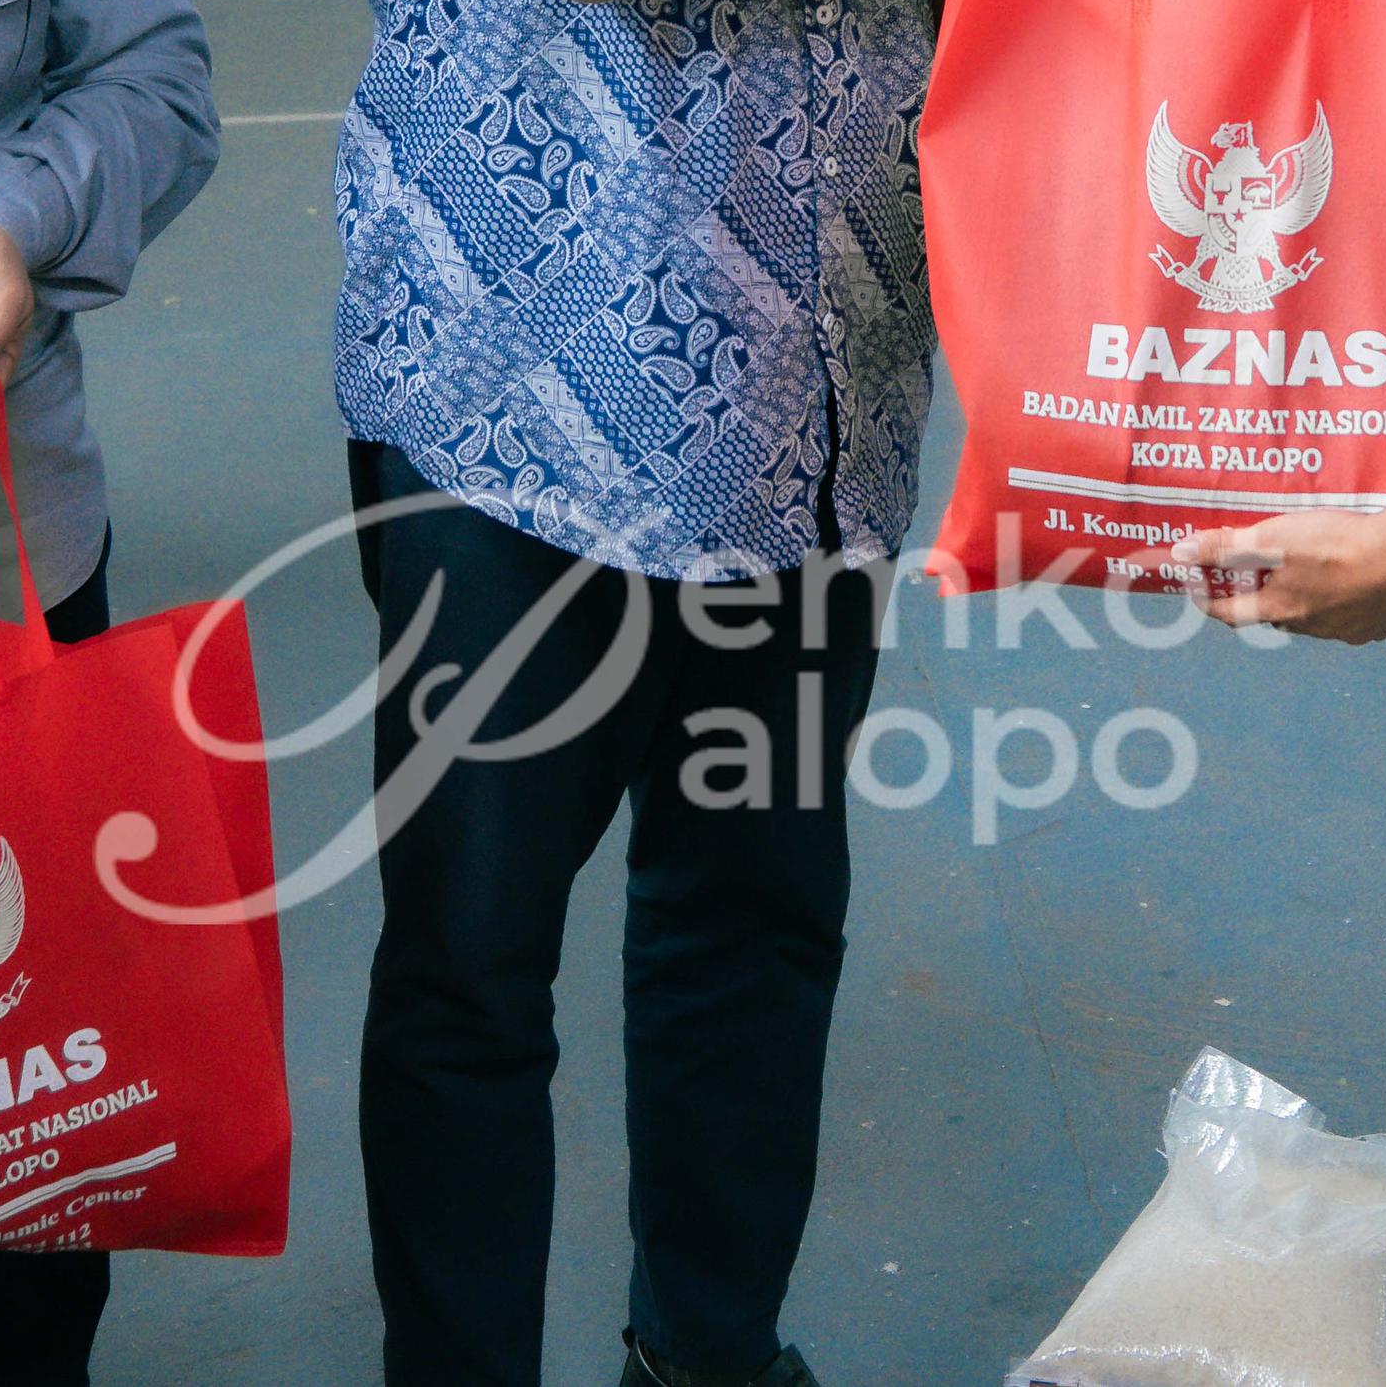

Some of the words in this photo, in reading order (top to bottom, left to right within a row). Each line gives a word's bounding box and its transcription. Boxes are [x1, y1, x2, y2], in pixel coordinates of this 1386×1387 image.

[1021, 389, 1119, 428] BADAN
[1122, 403, 1194, 433] AMIL
[1197, 406, 1291, 436] ZAKAT
[1130, 441, 1205, 471] KOTA
[1209, 444, 1324, 474] PALOPO
[1043, 507, 1076, 533] Jl.
[1104, 555, 1153, 582] Hp.
[1157, 562, 1205, 583] 085
[1209, 567, 1257, 587] 395
[28, 1077, 159, 1144] NASIONAL
[64, 1184, 148, 1219] Center
